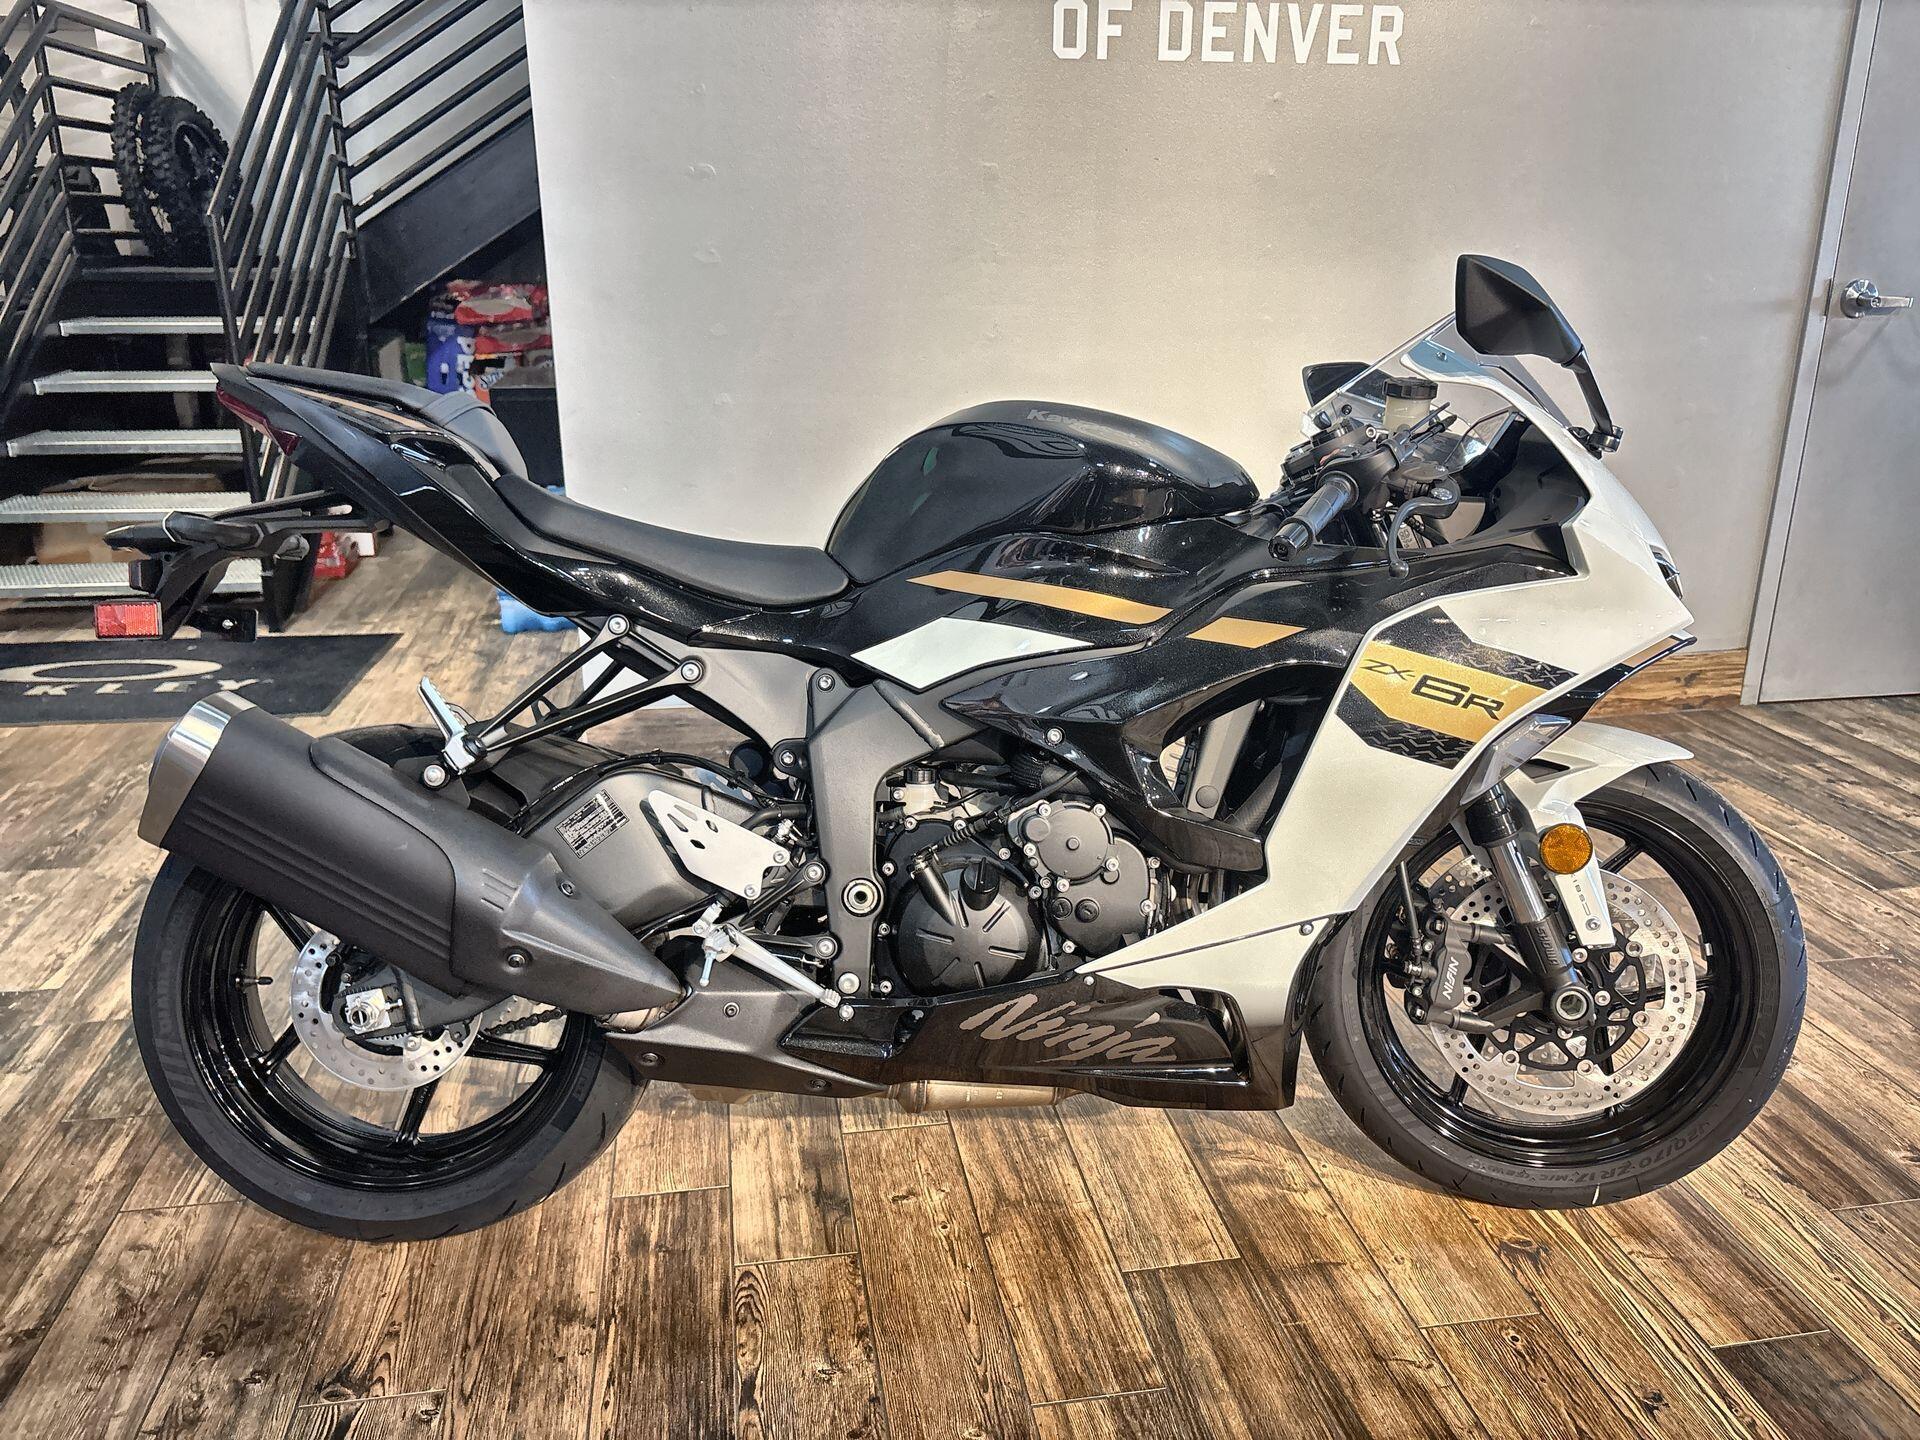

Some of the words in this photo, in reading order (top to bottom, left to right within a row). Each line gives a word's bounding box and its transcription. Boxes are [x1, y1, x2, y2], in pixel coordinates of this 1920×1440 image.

[1052, 0, 1132, 60] OF
[1157, 0, 1404, 65] DENVER
[1536, 926, 1560, 966] SHOWA
[1442, 956, 1459, 1001] NISSIN
[958, 992, 1178, 1064] Ninja
